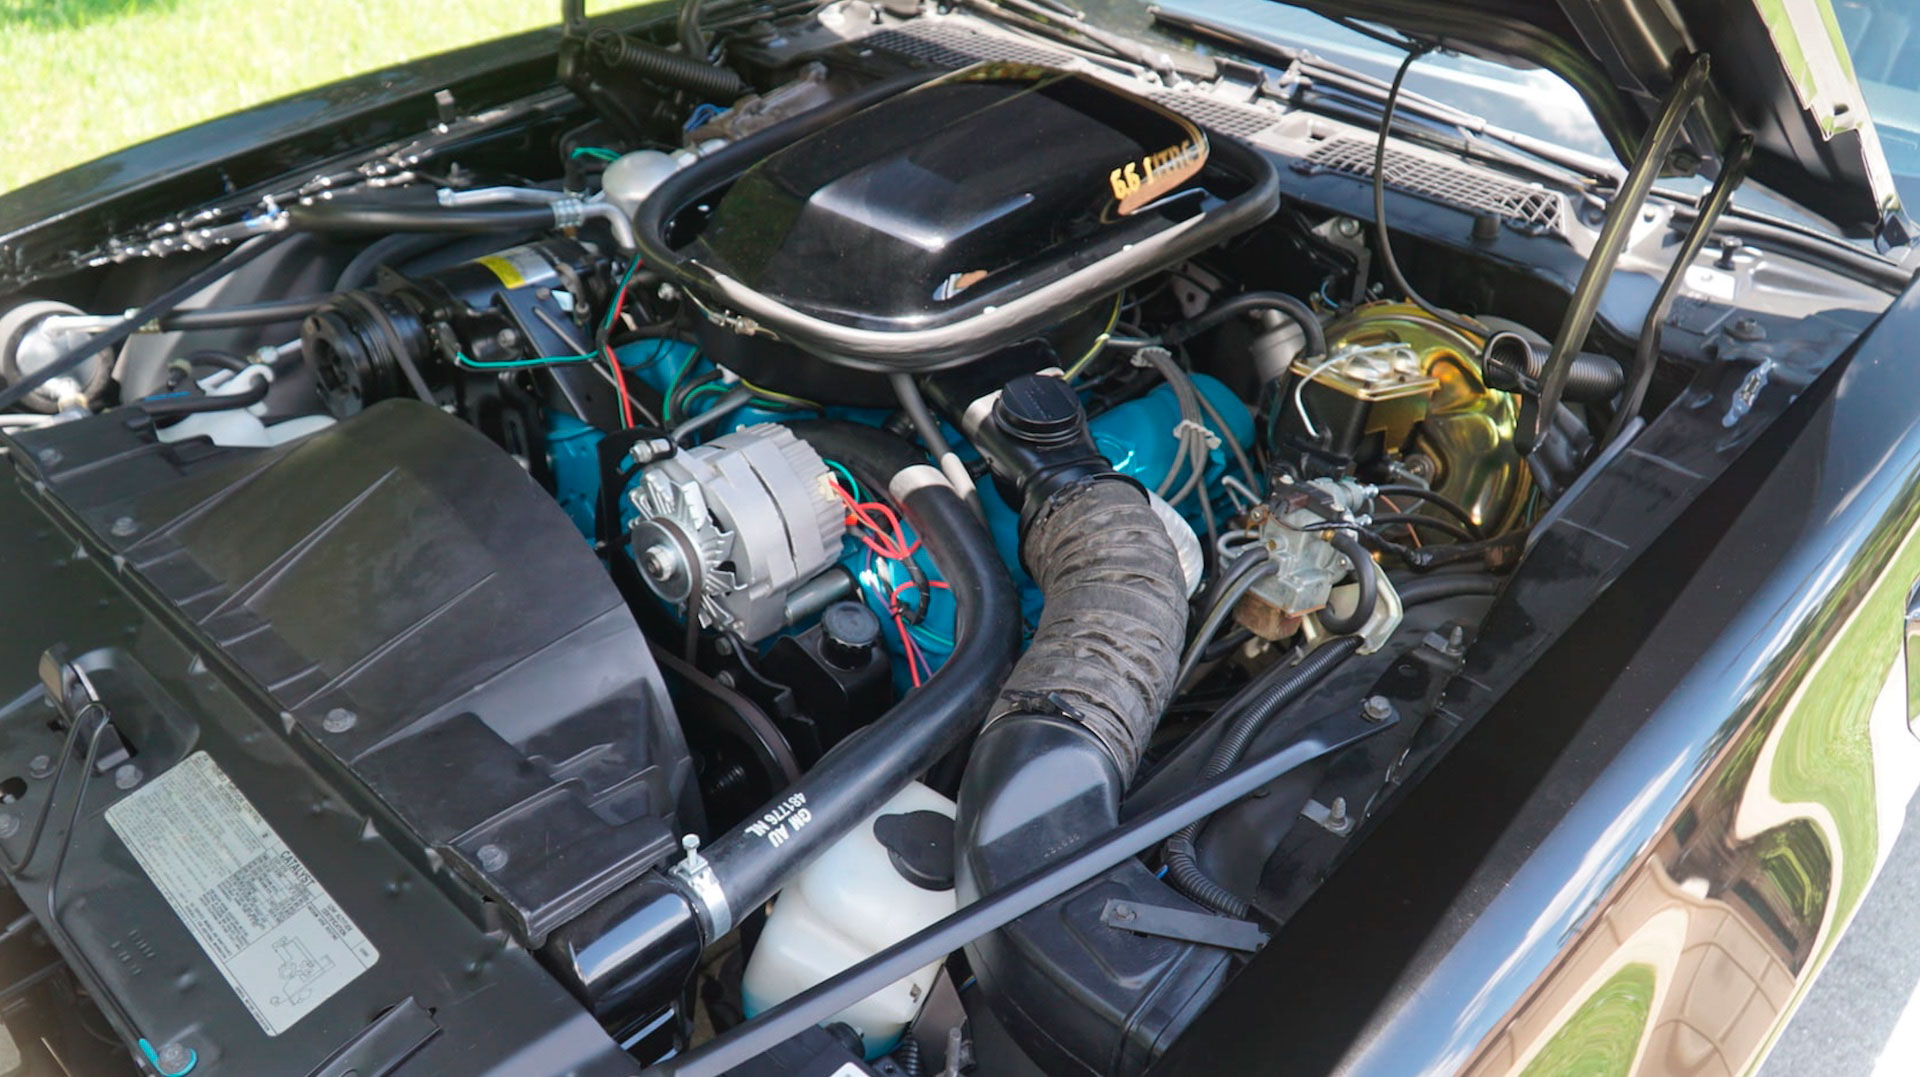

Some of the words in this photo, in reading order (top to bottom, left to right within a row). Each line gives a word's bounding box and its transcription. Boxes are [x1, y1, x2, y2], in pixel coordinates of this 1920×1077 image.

[764, 792, 806, 825] 481776
[788, 808, 812, 831] GM
[744, 820, 770, 837] NL
[768, 824, 790, 848] AU
[280, 850, 315, 887] CATALYST
